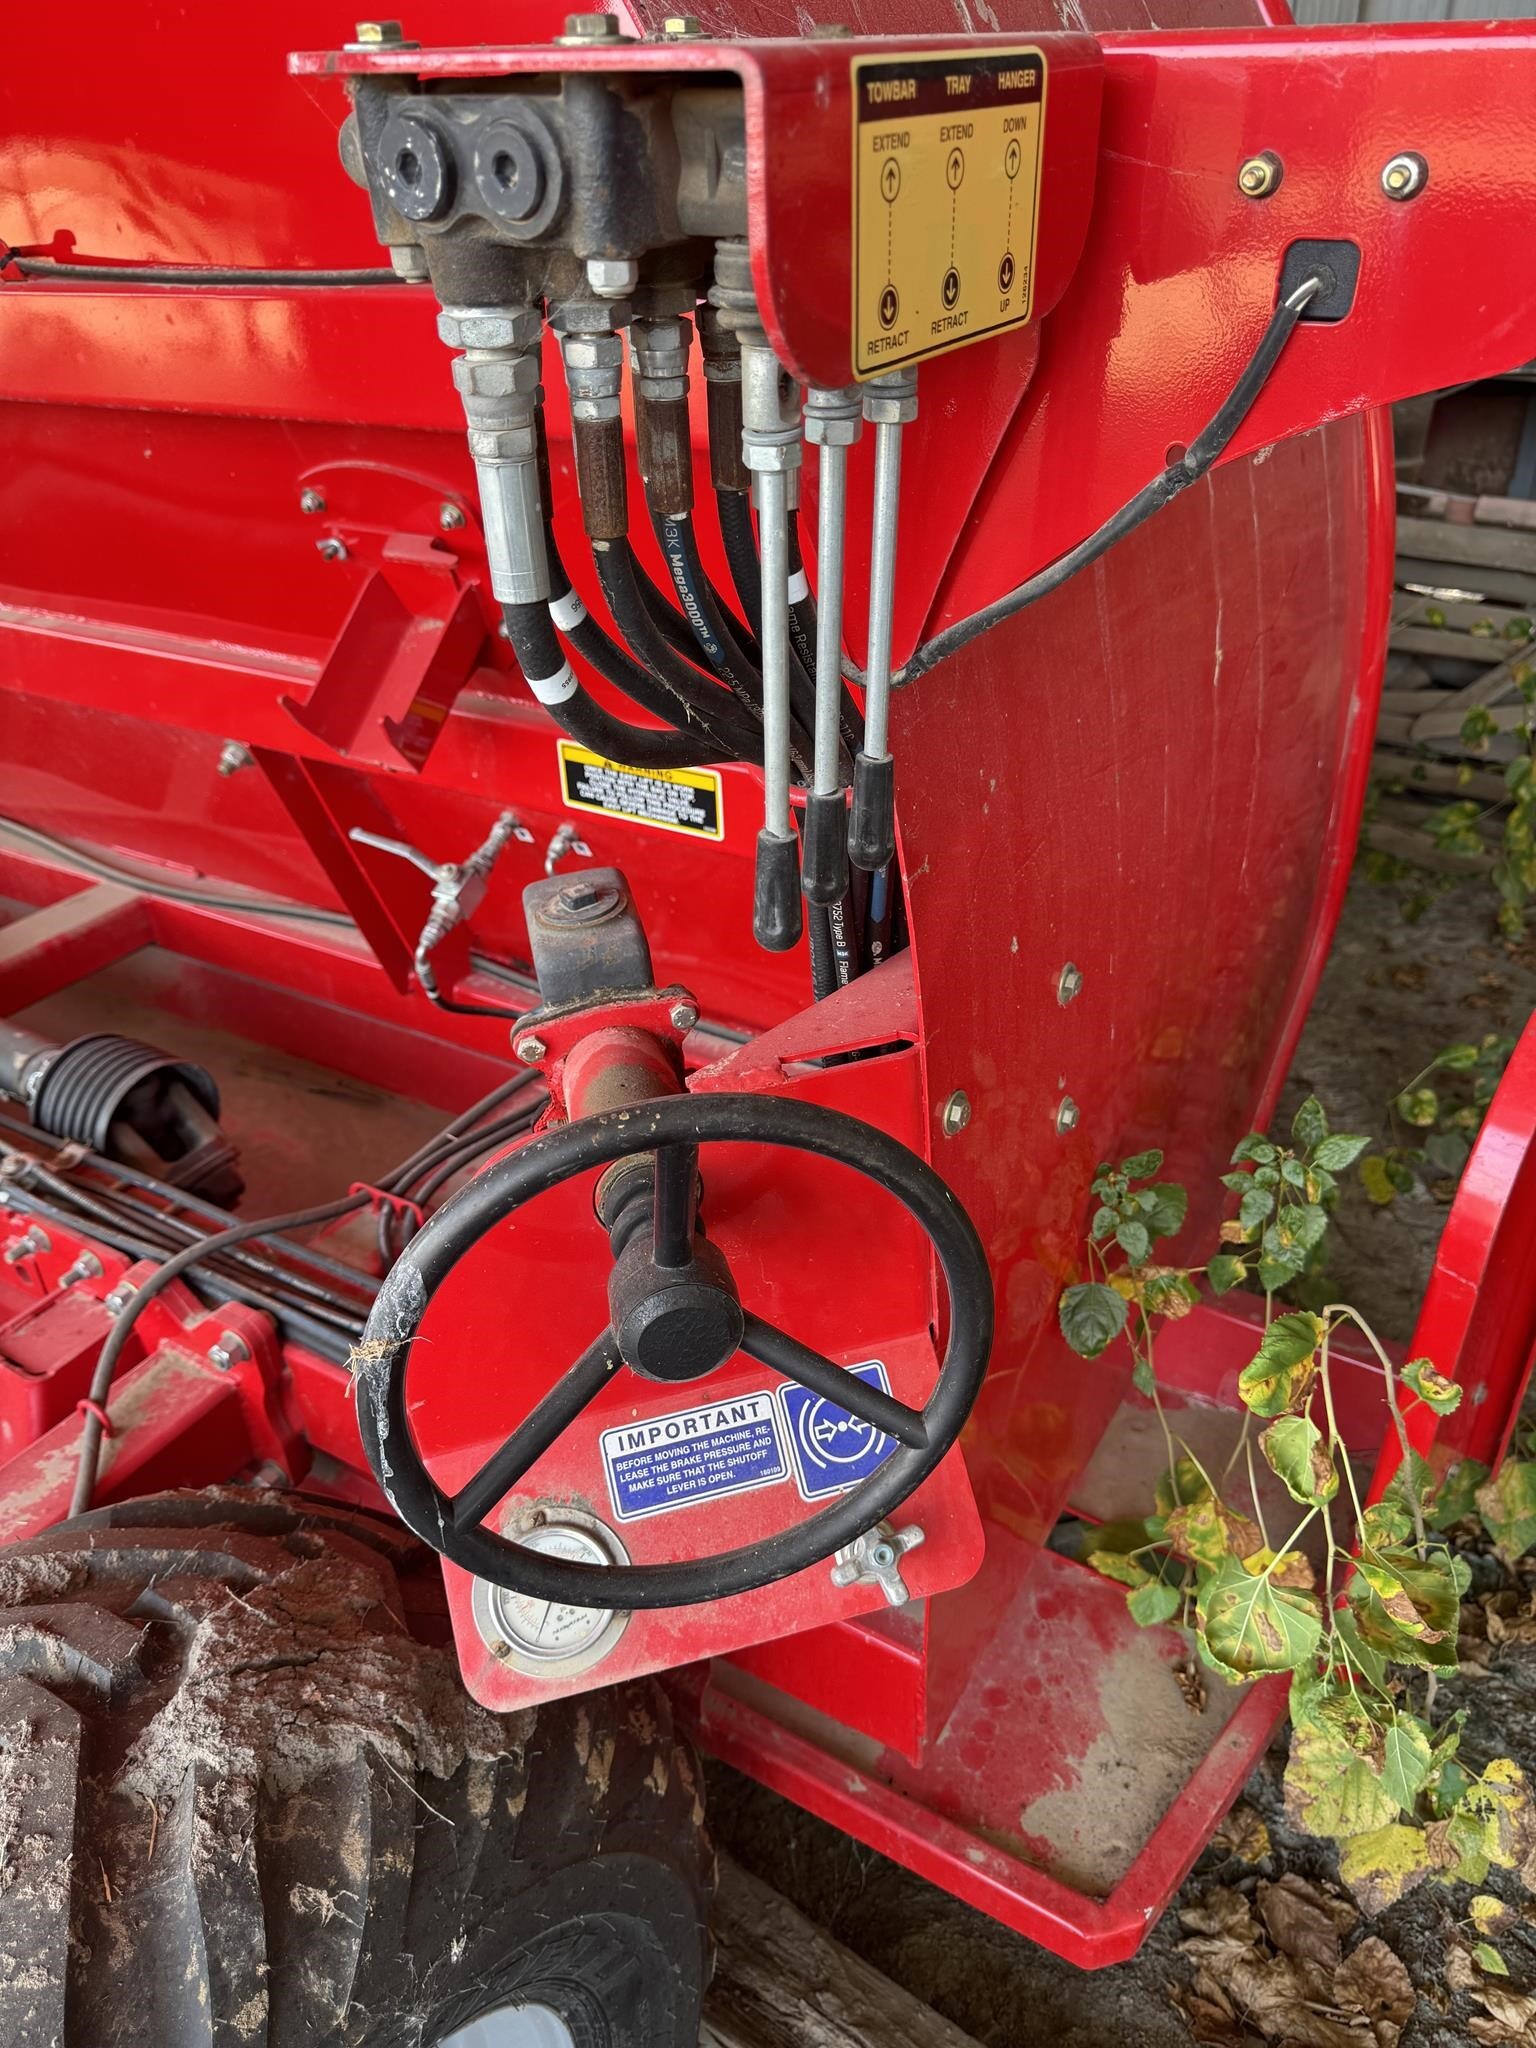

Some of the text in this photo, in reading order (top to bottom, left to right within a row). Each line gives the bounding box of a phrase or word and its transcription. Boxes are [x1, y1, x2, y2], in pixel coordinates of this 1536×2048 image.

[866, 69, 1036, 104] TOWBAR TRAY HANGER
[940, 123, 974, 142] EXTEND
[1003, 116, 1027, 133] DOWN
[872, 131, 910, 152] EXTEND
[1000, 298, 1010, 313] UP
[931, 311, 969, 335] RETRACT
[867, 330, 910, 356] RETRACT
[832, 921, 846, 941] Type
[839, 960, 849, 985] Flame
[618, 1401, 760, 1451] IMPORTANT
[616, 1425, 770, 1472] BEFORE MOVING THE MACHINE, RE-
[620, 1437, 772, 1483] LEASE THE BRAKE PRESSURE AND
[628, 1449, 768, 1493] MAKE SURE THAT THE SHUTOFF
[666, 1479, 696, 1495] LEVER
[697, 1477, 707, 1487] IS
[708, 1470, 736, 1484] OPEN.
